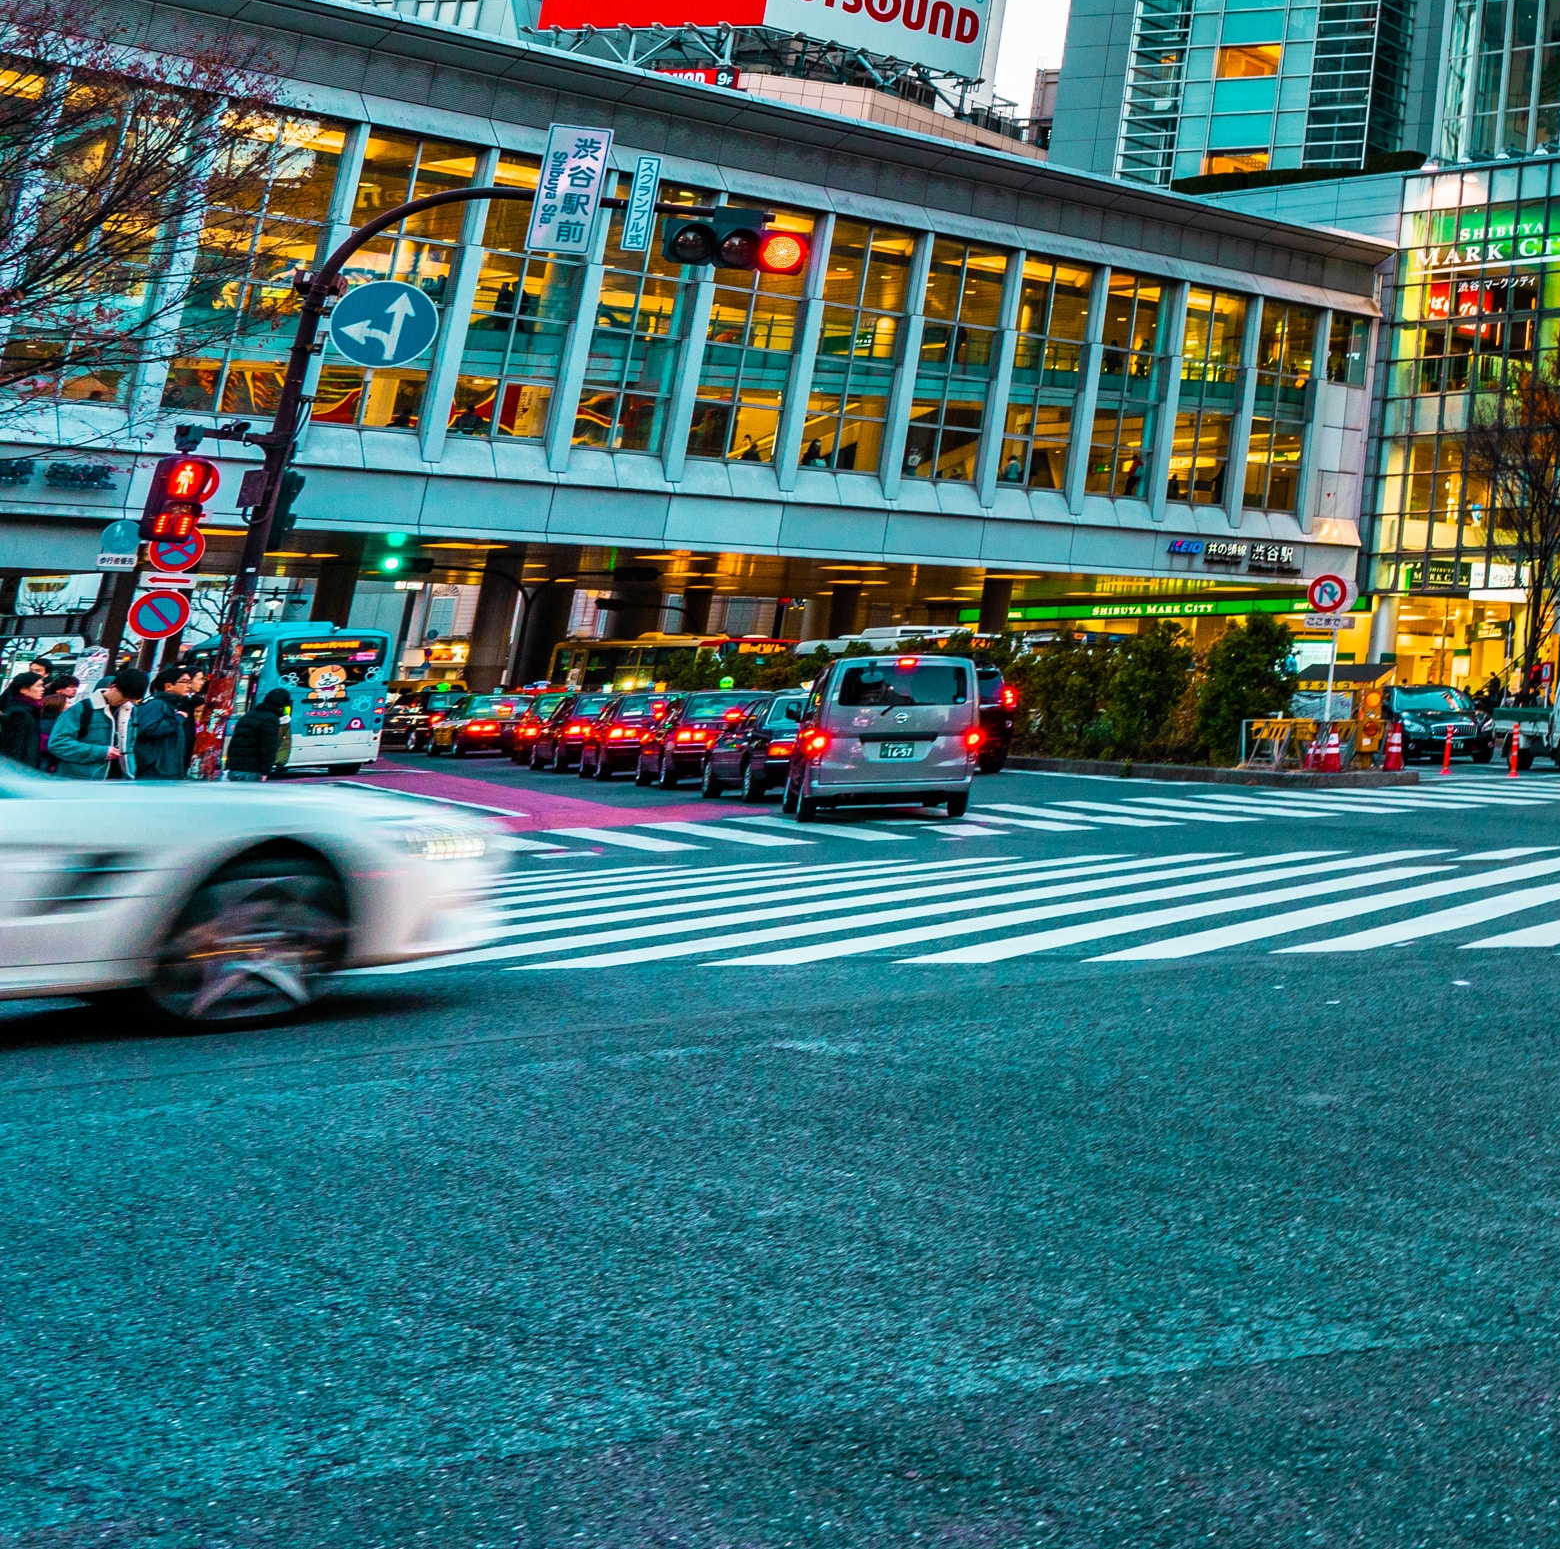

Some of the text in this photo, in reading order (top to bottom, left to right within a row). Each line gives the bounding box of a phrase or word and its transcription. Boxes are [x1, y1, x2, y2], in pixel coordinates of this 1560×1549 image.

[717, 72, 734, 86] 9F
[538, 150, 569, 229] Shibuya Sta.
[555, 137, 602, 244] 渋谷駅前
[628, 162, 656, 246] スクランブル式
[1460, 223, 1544, 242] SHIBUYA
[1415, 243, 1504, 268] MARK
[1457, 281, 1480, 293] 渋谷
[1168, 540, 1204, 554] KEIO
[1207, 542, 1294, 563] 井の頭線 渋谷駅
[1092, 603, 1215, 616] SHIBUYA MARK CITY
[1306, 617, 1342, 628] ここまで
